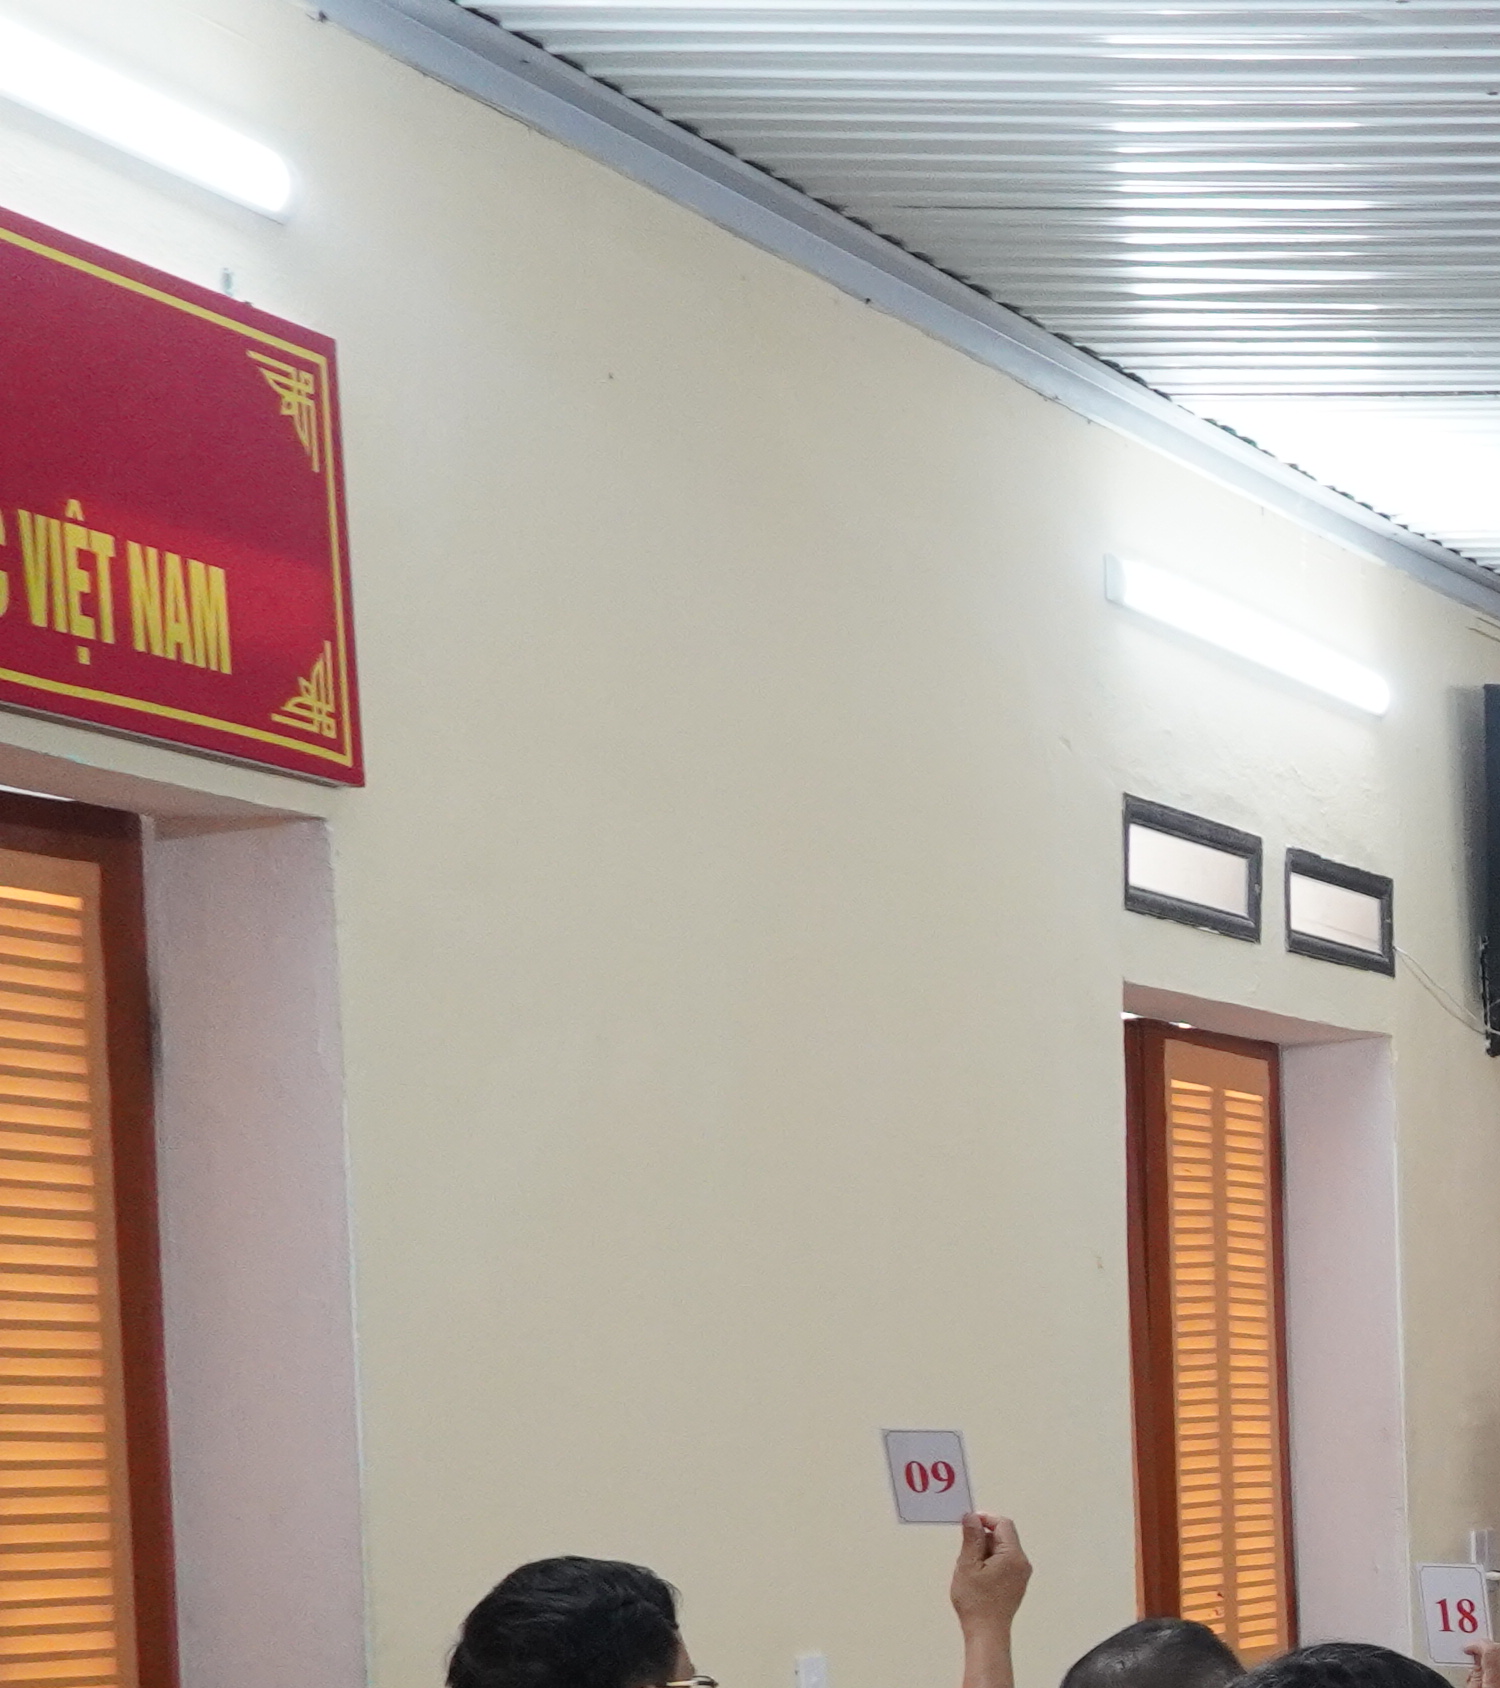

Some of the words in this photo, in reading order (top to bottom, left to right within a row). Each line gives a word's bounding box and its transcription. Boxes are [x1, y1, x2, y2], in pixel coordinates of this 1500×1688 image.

[17, 498, 116, 665] VIỆT
[126, 540, 232, 675] NAM
[904, 1461, 956, 1494] 09
[1437, 1598, 1479, 1635] 18
